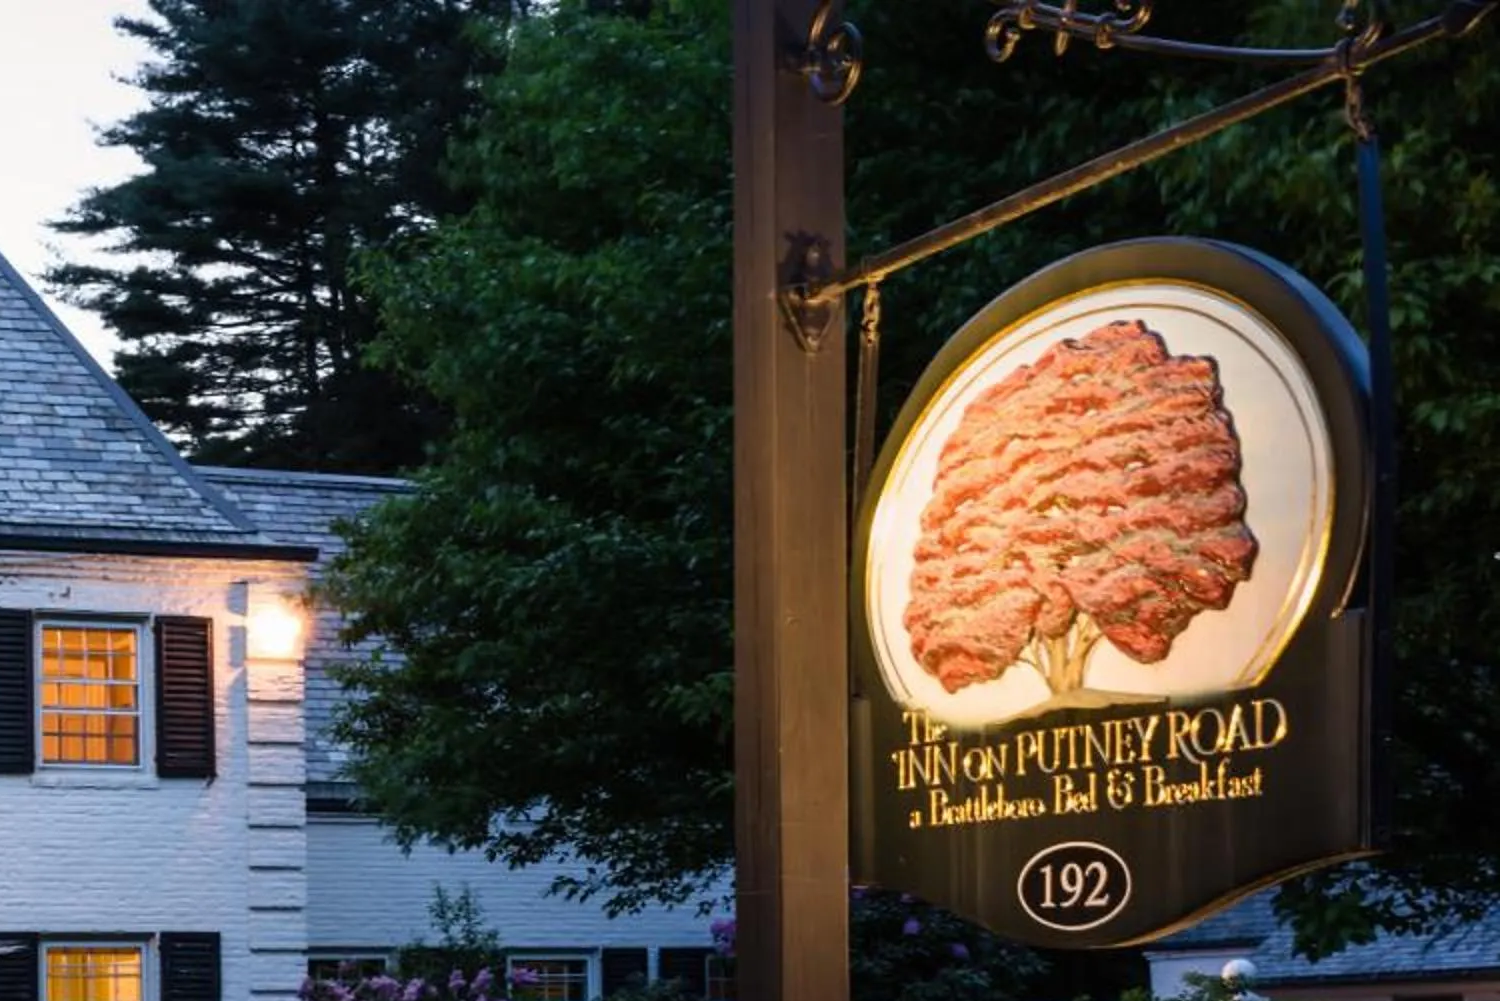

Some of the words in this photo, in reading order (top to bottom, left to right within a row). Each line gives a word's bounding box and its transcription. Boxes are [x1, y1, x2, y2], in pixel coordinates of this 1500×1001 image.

[892, 741, 959, 789] INN
[1016, 714, 1160, 776] PUTNEY
[1166, 698, 1288, 764] ROAD
[903, 710, 947, 744] The
[909, 810, 922, 828] a
[930, 783, 1046, 825] Brattleboro
[1054, 772, 1098, 814] Bed
[1107, 768, 1135, 809] &
[1142, 757, 1263, 806] Breakfast
[1039, 861, 1110, 909] 192
